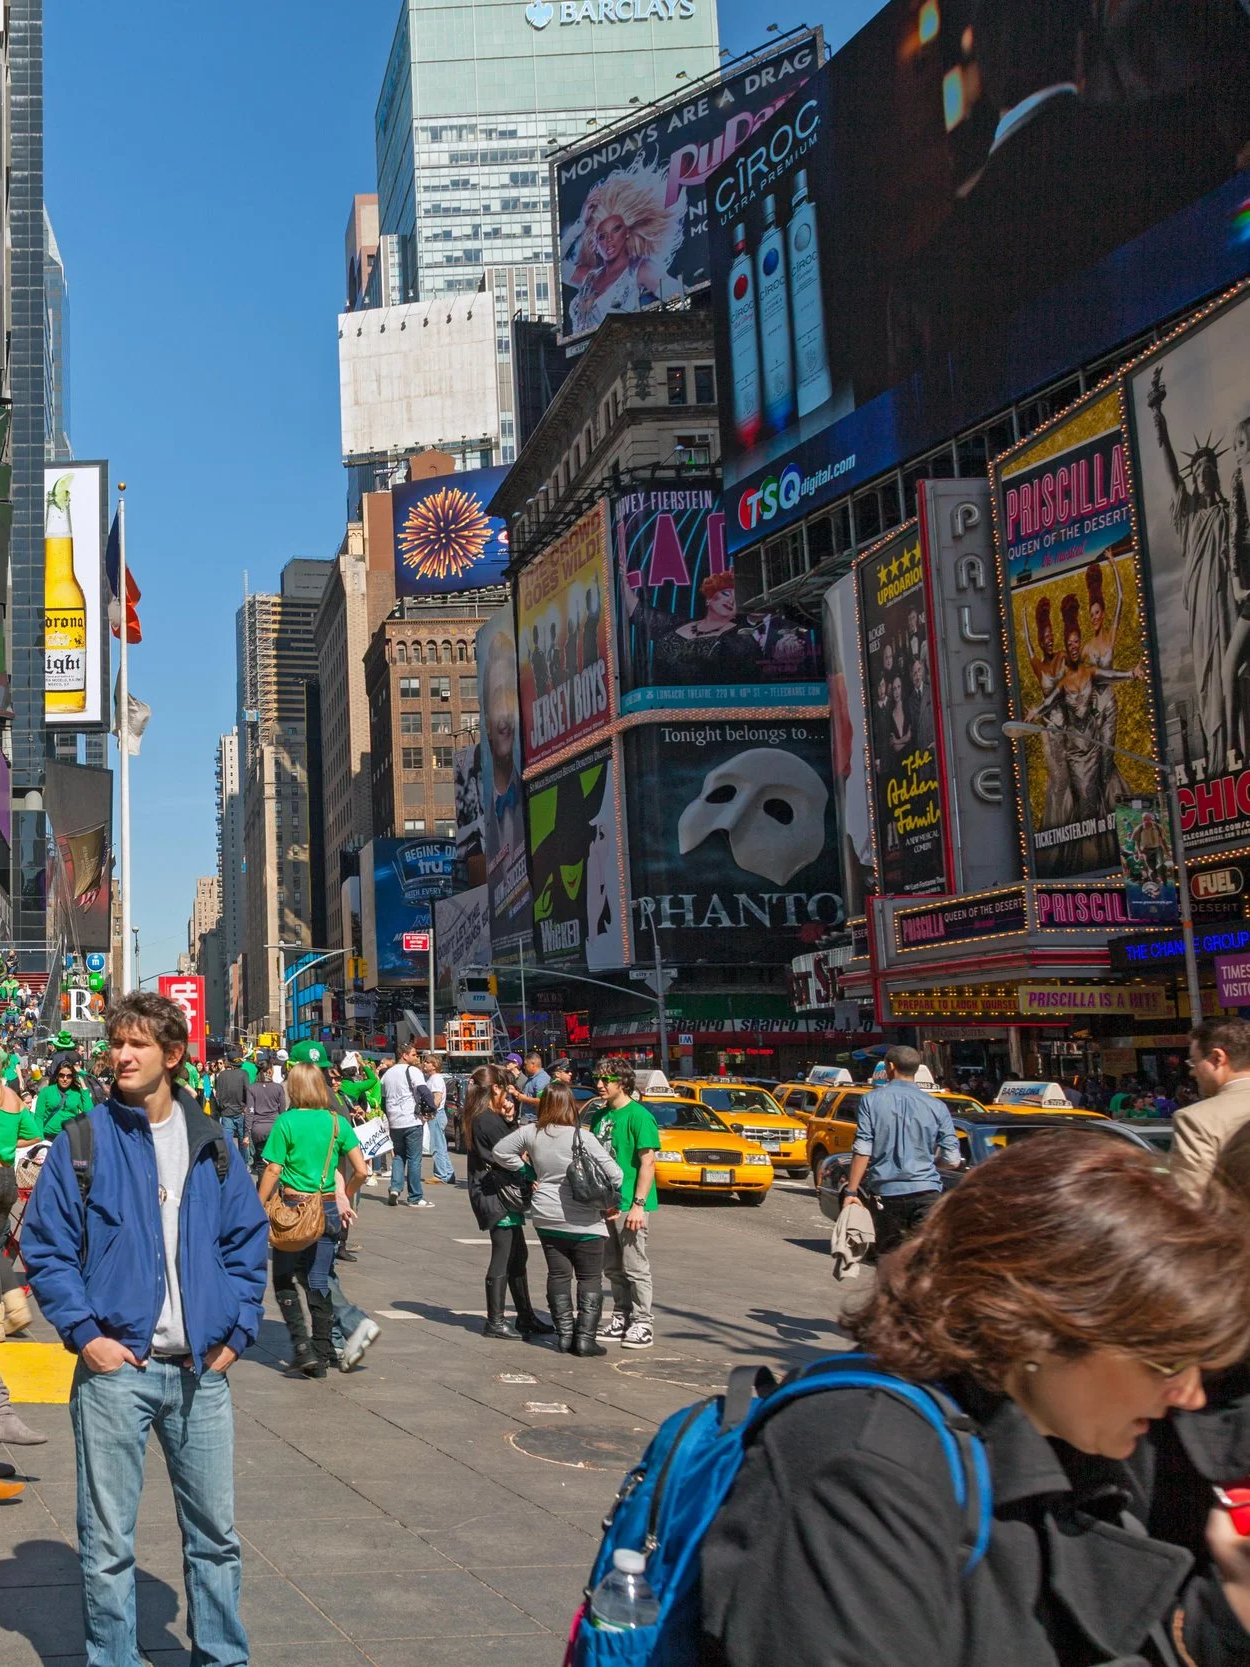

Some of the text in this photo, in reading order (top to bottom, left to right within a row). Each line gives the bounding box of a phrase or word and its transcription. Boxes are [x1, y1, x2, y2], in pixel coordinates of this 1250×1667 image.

[559, 0, 697, 25] BARCLAYS
[561, 49, 814, 185] MONDAYS ARE A DRAG
[720, 134, 818, 226] ULTRA PREMIUM
[651, 490, 713, 511] FIERSTEIN
[1006, 444, 1130, 548] PRISCILLA
[1008, 505, 1129, 561] QUEEN OF THE DESERT
[950, 500, 1005, 801] PALACE
[531, 680, 571, 750] JERSEY
[573, 658, 608, 725] BOYS
[661, 725, 720, 746] Tonight
[725, 725, 787, 744] belongs
[902, 749, 933, 776] The
[1034, 817, 1097, 849] TICKETMASTER.COM
[405, 844, 441, 863] BEGINS
[1197, 870, 1236, 896] FUEL
[944, 898, 1023, 923] QUEEN OF THE DESERT
[1037, 893, 1140, 922] PRISCIL
[902, 913, 946, 943] PRISCILLA
[1125, 930, 1250, 960] THE CHANE GROUP
[68, 989, 100, 1022] R
[938, 999, 978, 1009] TO LAUGH
[1100, 992, 1112, 1007] IS
[1117, 992, 1125, 1007] A
[670, 1017, 799, 1032] sbarro sbarro
[1001, 1087, 1040, 1097] BARCELONA
